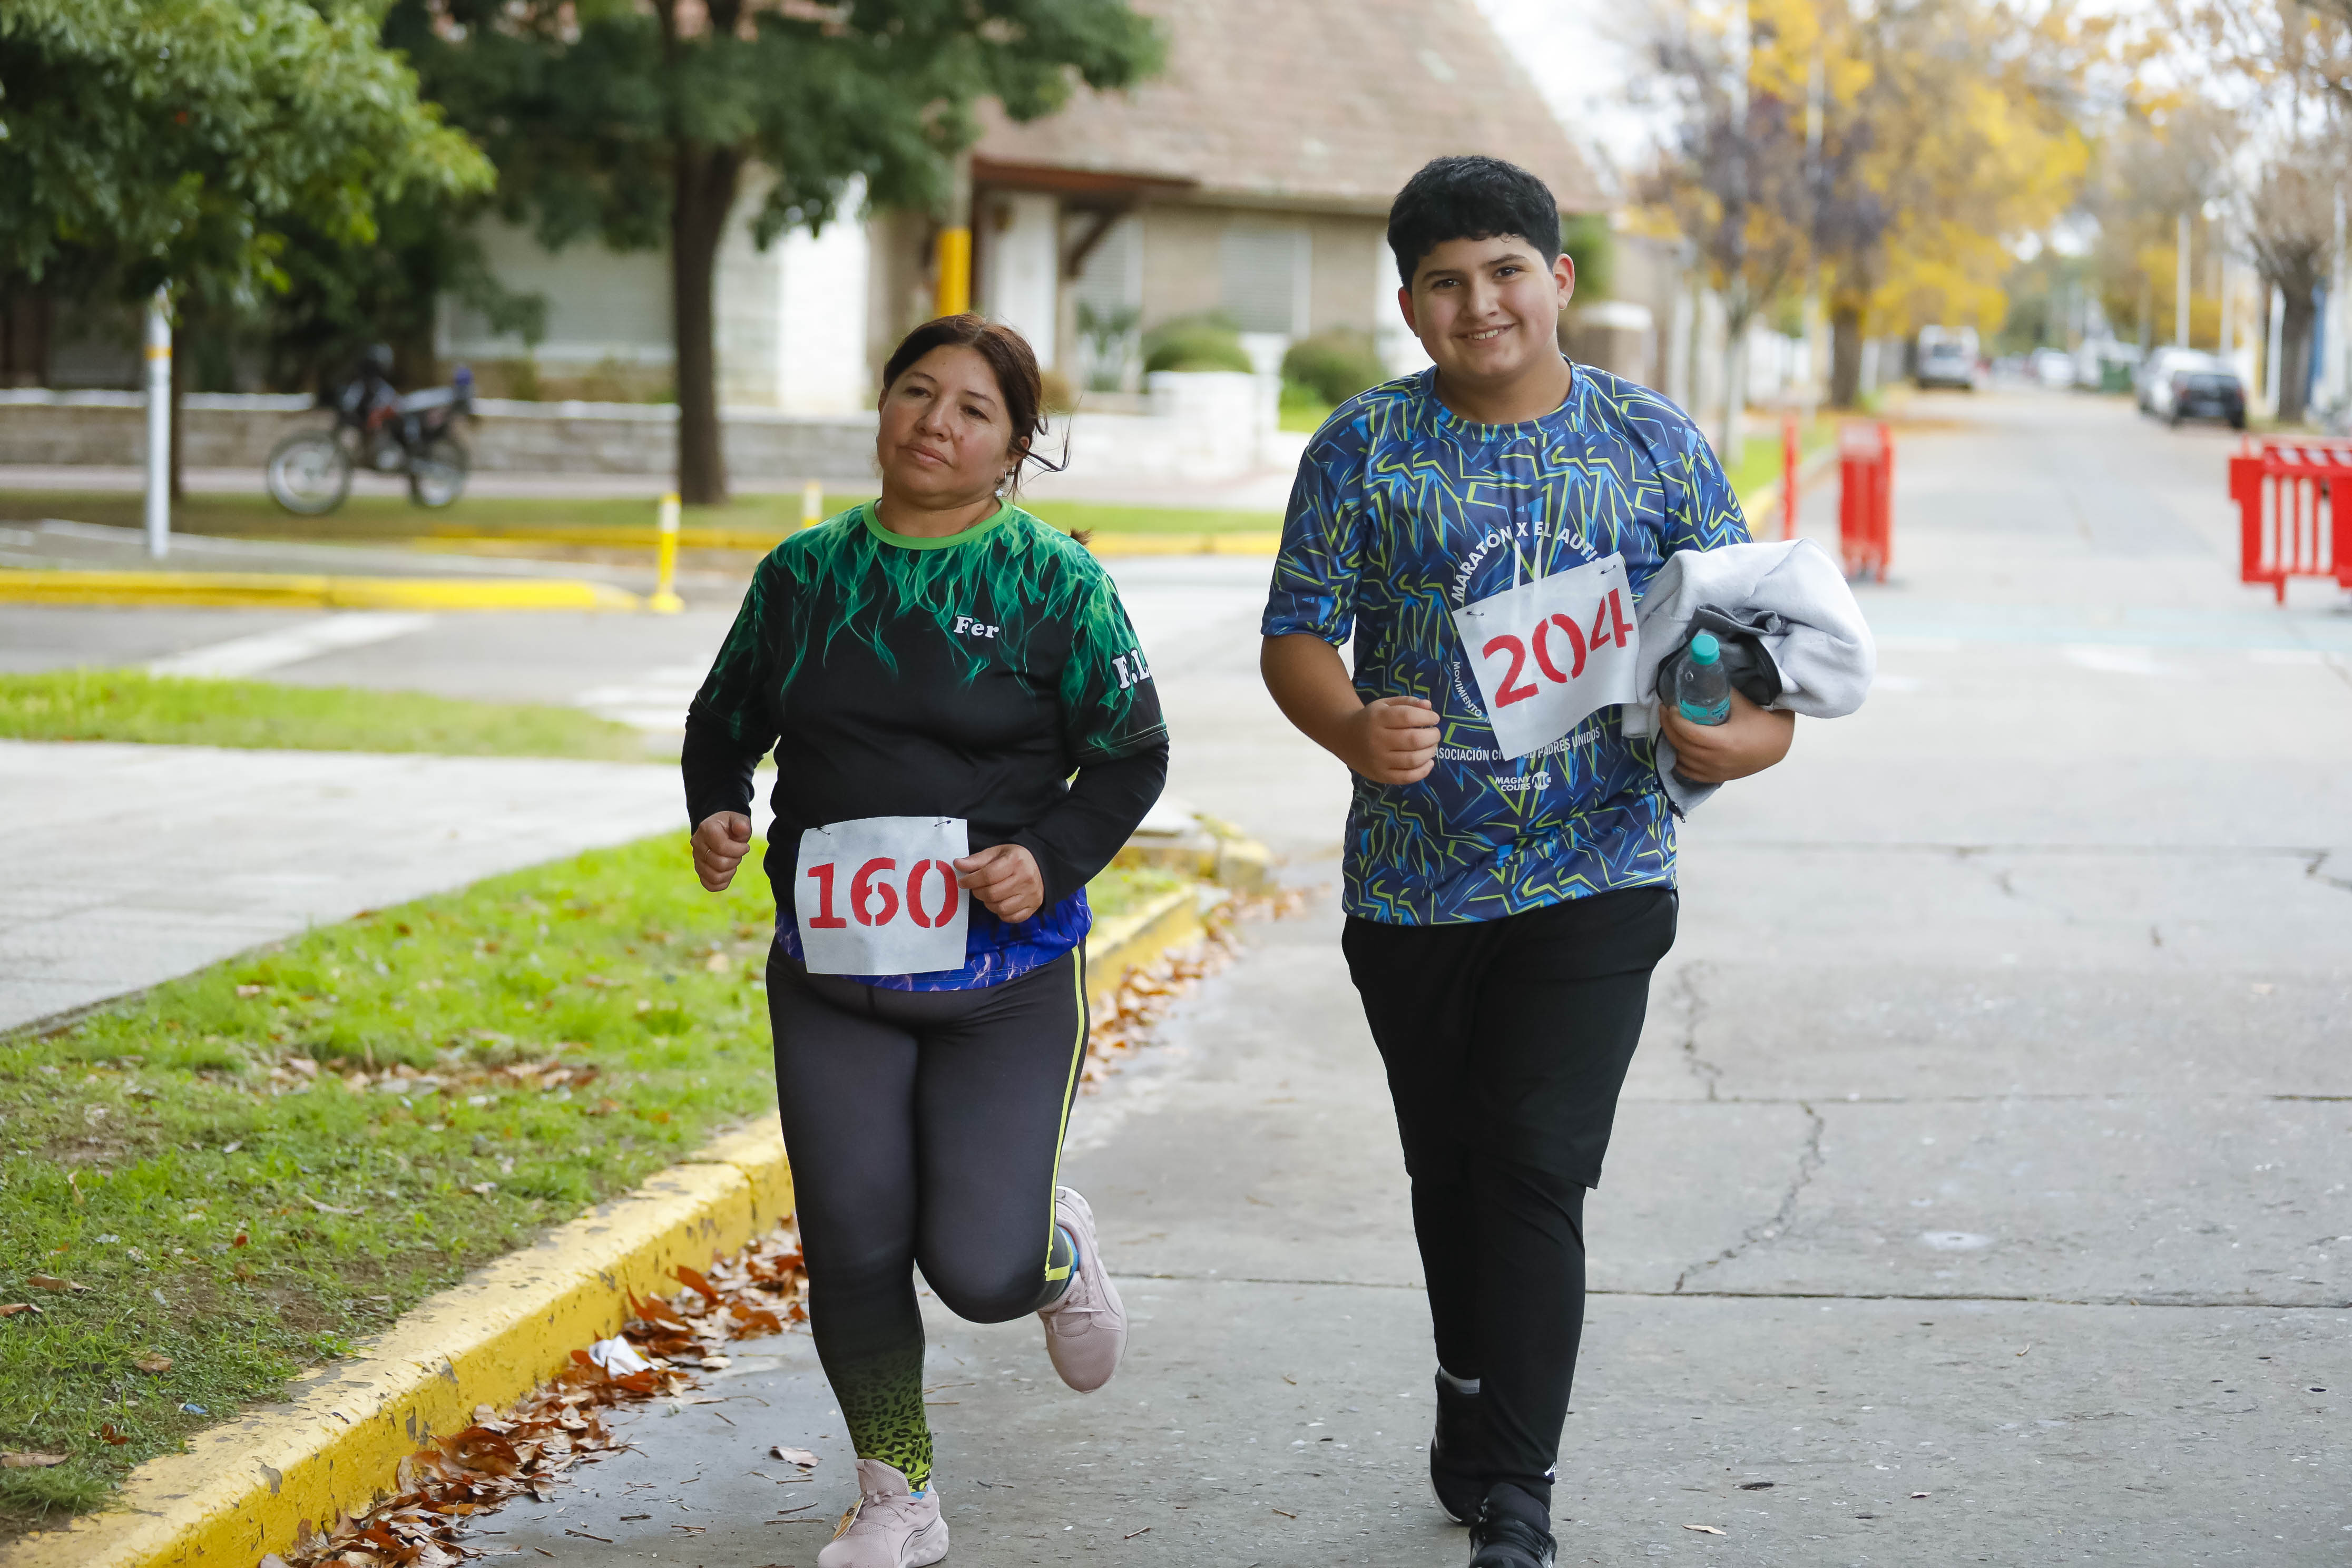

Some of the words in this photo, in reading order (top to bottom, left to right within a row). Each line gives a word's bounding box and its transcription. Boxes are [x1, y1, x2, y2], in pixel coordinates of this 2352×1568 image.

[1451, 525, 1514, 603] MARATÓN
[1516, 522, 1529, 537] X
[1534, 521, 1552, 538] EL
[1556, 528, 1602, 563] AUTI
[953, 615, 999, 639] Fer
[1482, 587, 1634, 709] 204
[1572, 727, 1600, 747] UNIDOS
[1495, 775, 1531, 785] MAGNY
[1501, 783, 1531, 791] COURS
[807, 857, 959, 929] 160
